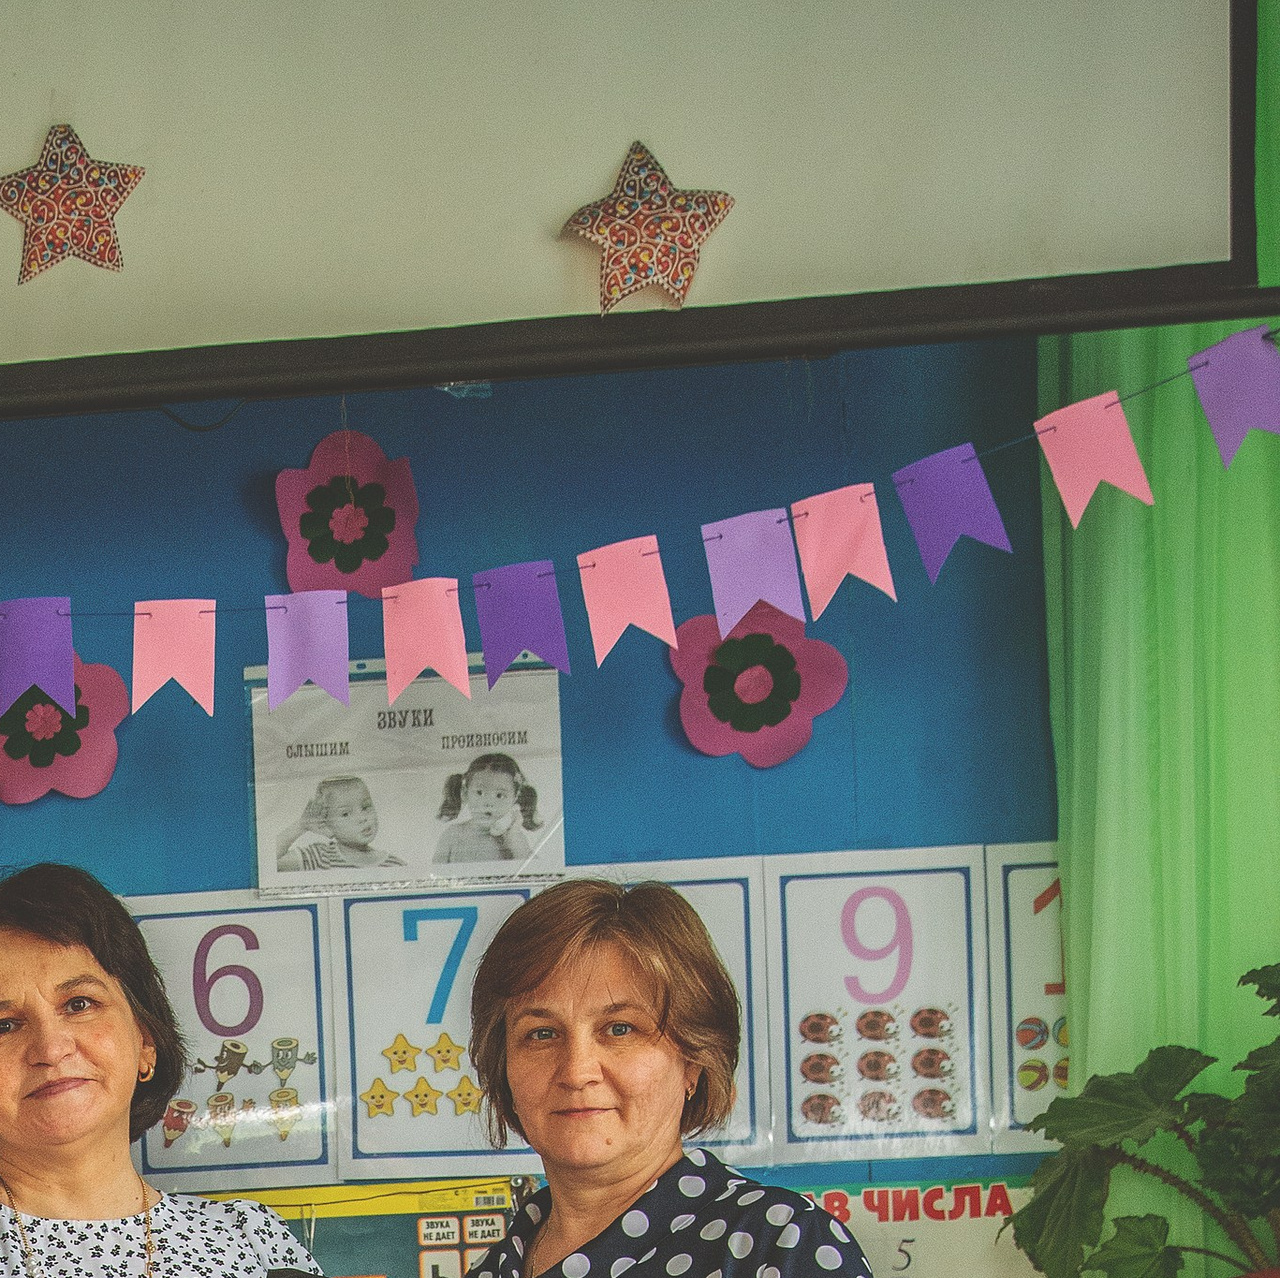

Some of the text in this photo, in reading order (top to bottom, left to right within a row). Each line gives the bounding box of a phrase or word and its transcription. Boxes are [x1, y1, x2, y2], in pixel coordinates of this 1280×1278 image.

[377, 708, 435, 730] ЗВУКИ
[286, 742, 350, 759] СЛЫШИМ
[441, 731, 528, 750] ПРОИЗНОСИМ
[840, 886, 914, 1005] 9
[403, 906, 478, 1025] 7
[193, 924, 264, 1038] 6
[863, 1183, 1014, 1223] ЧИСЛА
[425, 1220, 451, 1230] ЗВУКА
[470, 1218, 496, 1228] ЗВУКА
[423, 1231, 456, 1242] НЕ ДАЕТ
[468, 1229, 501, 1240] НЕ ДАЕТ
[891, 1238, 916, 1272] 5
